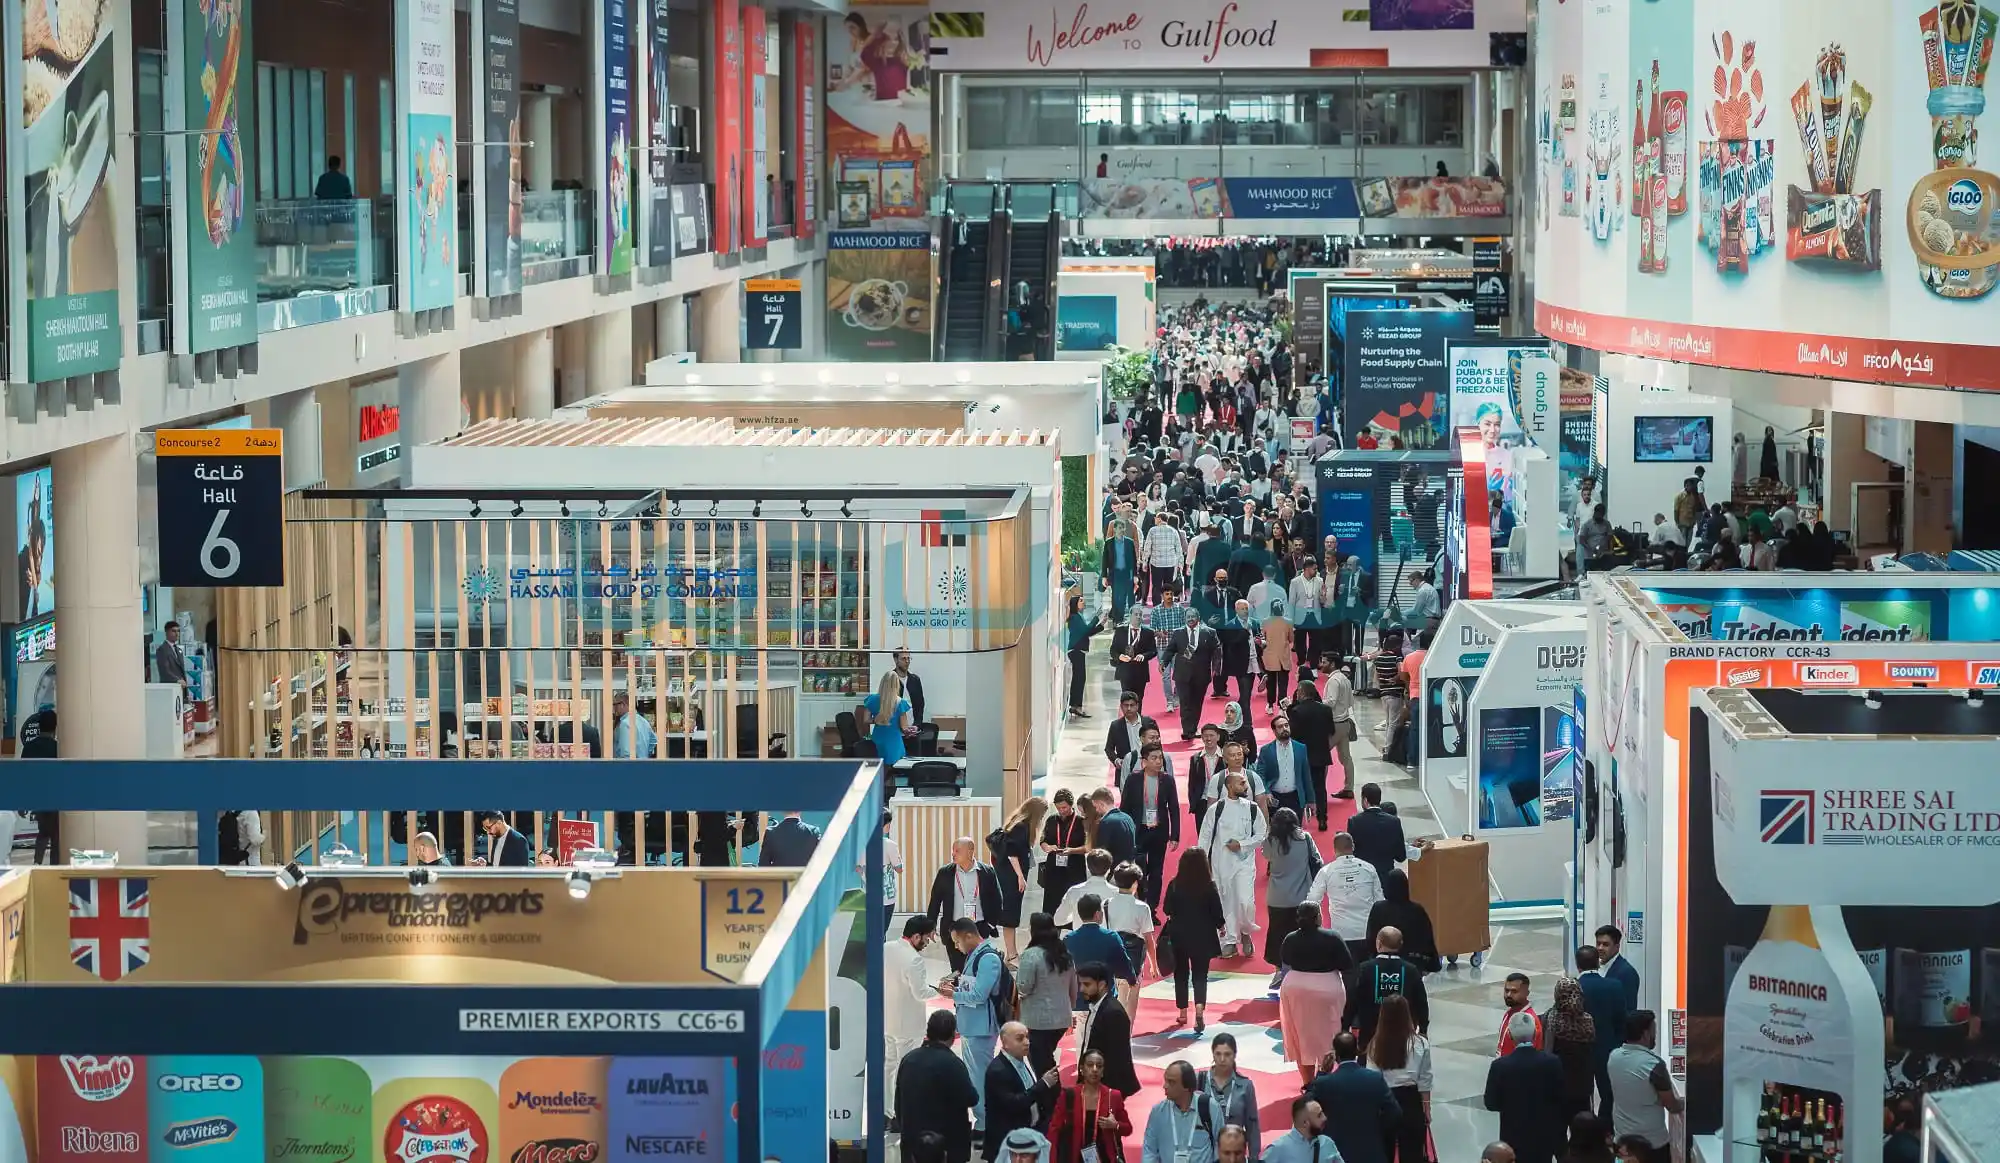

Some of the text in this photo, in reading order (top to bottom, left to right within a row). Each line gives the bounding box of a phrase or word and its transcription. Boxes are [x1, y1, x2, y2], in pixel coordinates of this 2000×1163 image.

[1027, 3, 1143, 66] Welcome
[1161, 2, 1277, 63] Gulfood
[1123, 40, 1141, 50] TO
[1664, 153, 1683, 165] TOMATO
[1666, 165, 1681, 176] PASTE
[1722, 165, 1744, 204] FINNS
[1248, 187, 1335, 199] MAHMOOD RICE
[1459, 206, 1500, 214] MAHMOOD
[1802, 204, 1836, 232] Quanta
[833, 236, 922, 247] MAHMOOD RICE
[1805, 235, 1825, 249] ALMOND
[762, 294, 785, 303] قاعة
[766, 305, 782, 313] Hall
[764, 314, 784, 346] 7
[1360, 347, 1421, 358] Nurturing the
[1360, 359, 1442, 368] Food Supply Chain
[1863, 354, 1889, 368] IFFCO
[1456, 368, 1492, 376] DUBAI'S
[1456, 386, 1505, 394] FREEZONE
[1532, 371, 1548, 432] HTgroup
[739, 415, 799, 424] www.hfza.ae
[159, 437, 221, 447] Concourse 2
[245, 437, 277, 447] ردهة 2
[194, 463, 244, 481] قاعة
[203, 488, 237, 503] Hall
[200, 509, 241, 579] 6
[1723, 622, 1822, 641] Trident
[1669, 646, 1831, 658] BRAND FACTORY CCR-43
[1728, 668, 1761, 684] Nestlé
[1807, 667, 1849, 680] Kinder
[1891, 666, 1935, 677] BOUNTY
[1823, 789, 1955, 810] SHREE SAI
[1823, 812, 1946, 832] TRADING
[1864, 835, 2000, 846] WHOLESALER OF FMCG
[340, 888, 545, 922] premier exports
[726, 887, 765, 914] 12
[388, 909, 445, 928] london
[724, 923, 765, 934] YEAR'S
[341, 932, 383, 945] BRITISH
[386, 932, 476, 945] CONFECTIONERY
[491, 932, 542, 945] GROCERY
[738, 941, 751, 950] IN
[716, 953, 751, 963] BUSIN
[1749, 974, 1827, 1001] BRITANNICA
[466, 1012, 737, 1029] PREMIER EXPORTS CC6-6
[1760, 1024, 1796, 1046] Celebration
[62, 1056, 132, 1090] Vimto
[158, 1074, 242, 1092] OREO
[626, 1072, 709, 1095] LAVAZZA
[61, 1126, 140, 1153] Ribena
[173, 1121, 228, 1144] McVitie's
[273, 1137, 355, 1157] Thorntons
[515, 1141, 600, 1163] Mars
